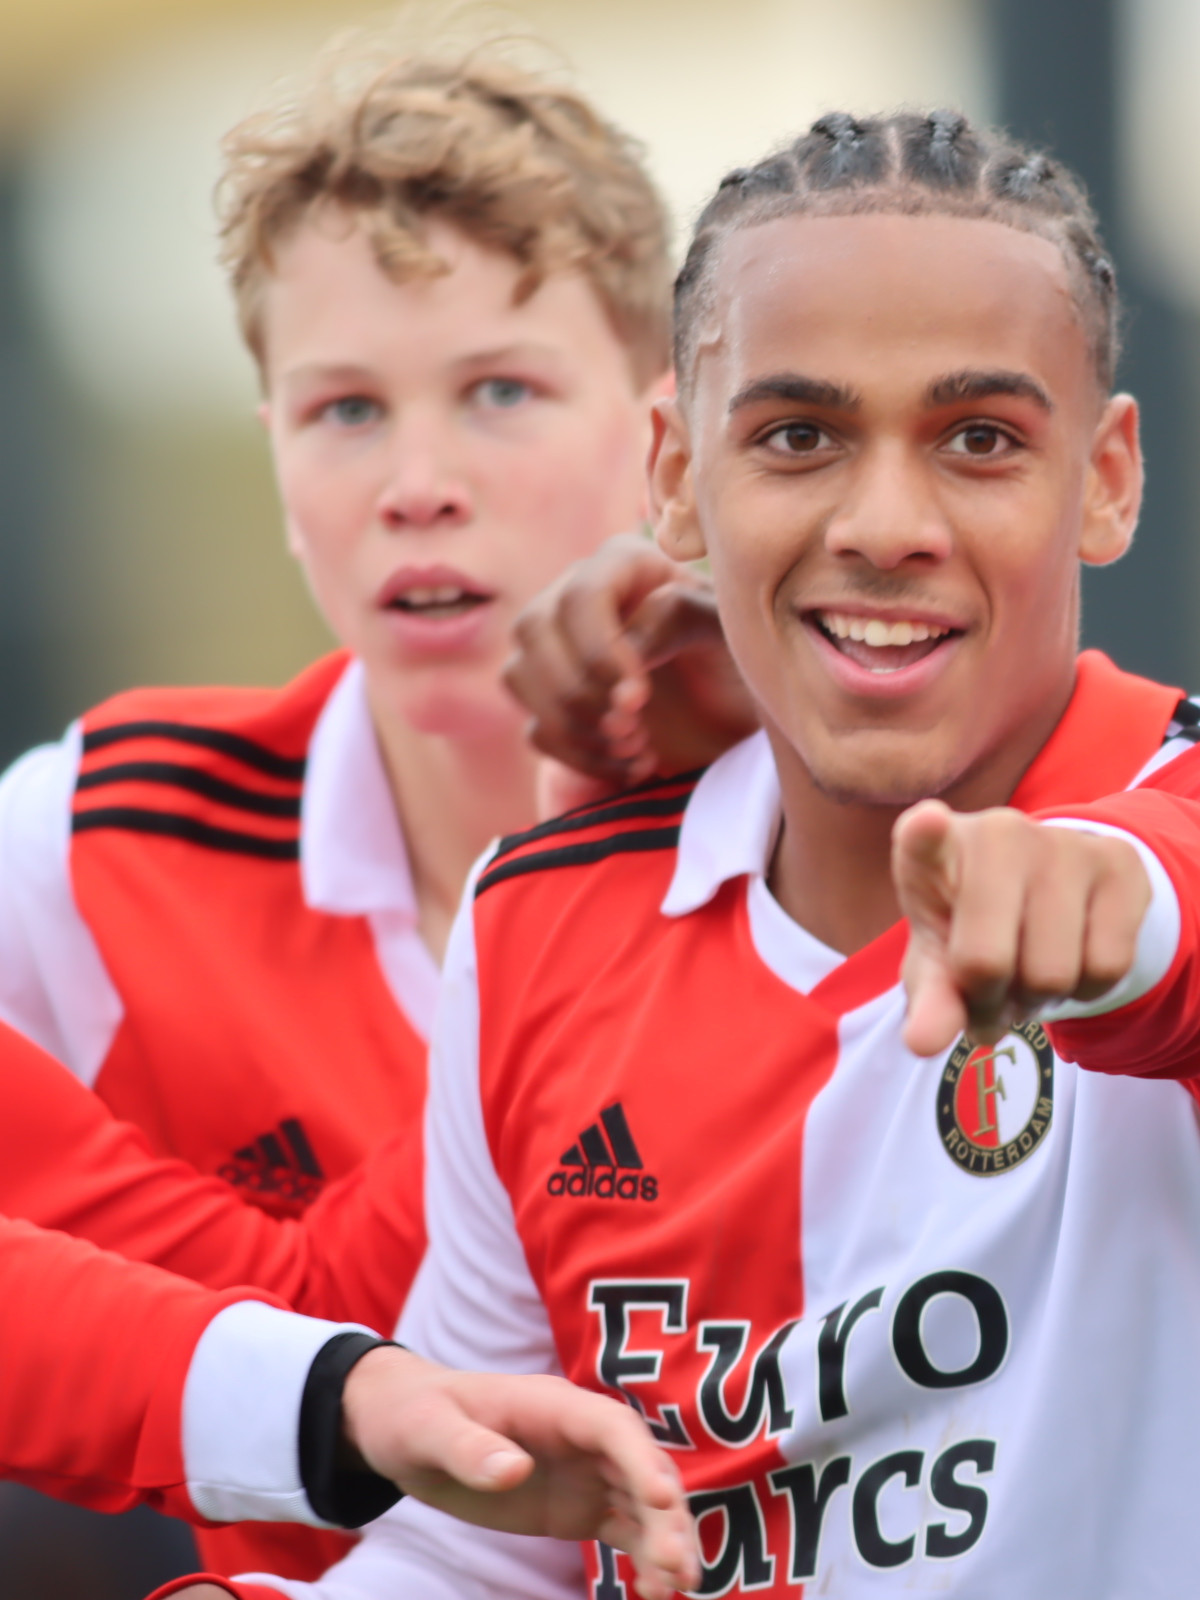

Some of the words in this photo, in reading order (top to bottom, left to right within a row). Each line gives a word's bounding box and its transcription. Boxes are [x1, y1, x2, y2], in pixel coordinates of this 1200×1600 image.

[547, 1164, 659, 1202] adidas
[945, 1097, 1053, 1171] ROTTERDAM
[588, 1269, 1011, 1450] Euro
[593, 1438, 998, 1600] arcs
